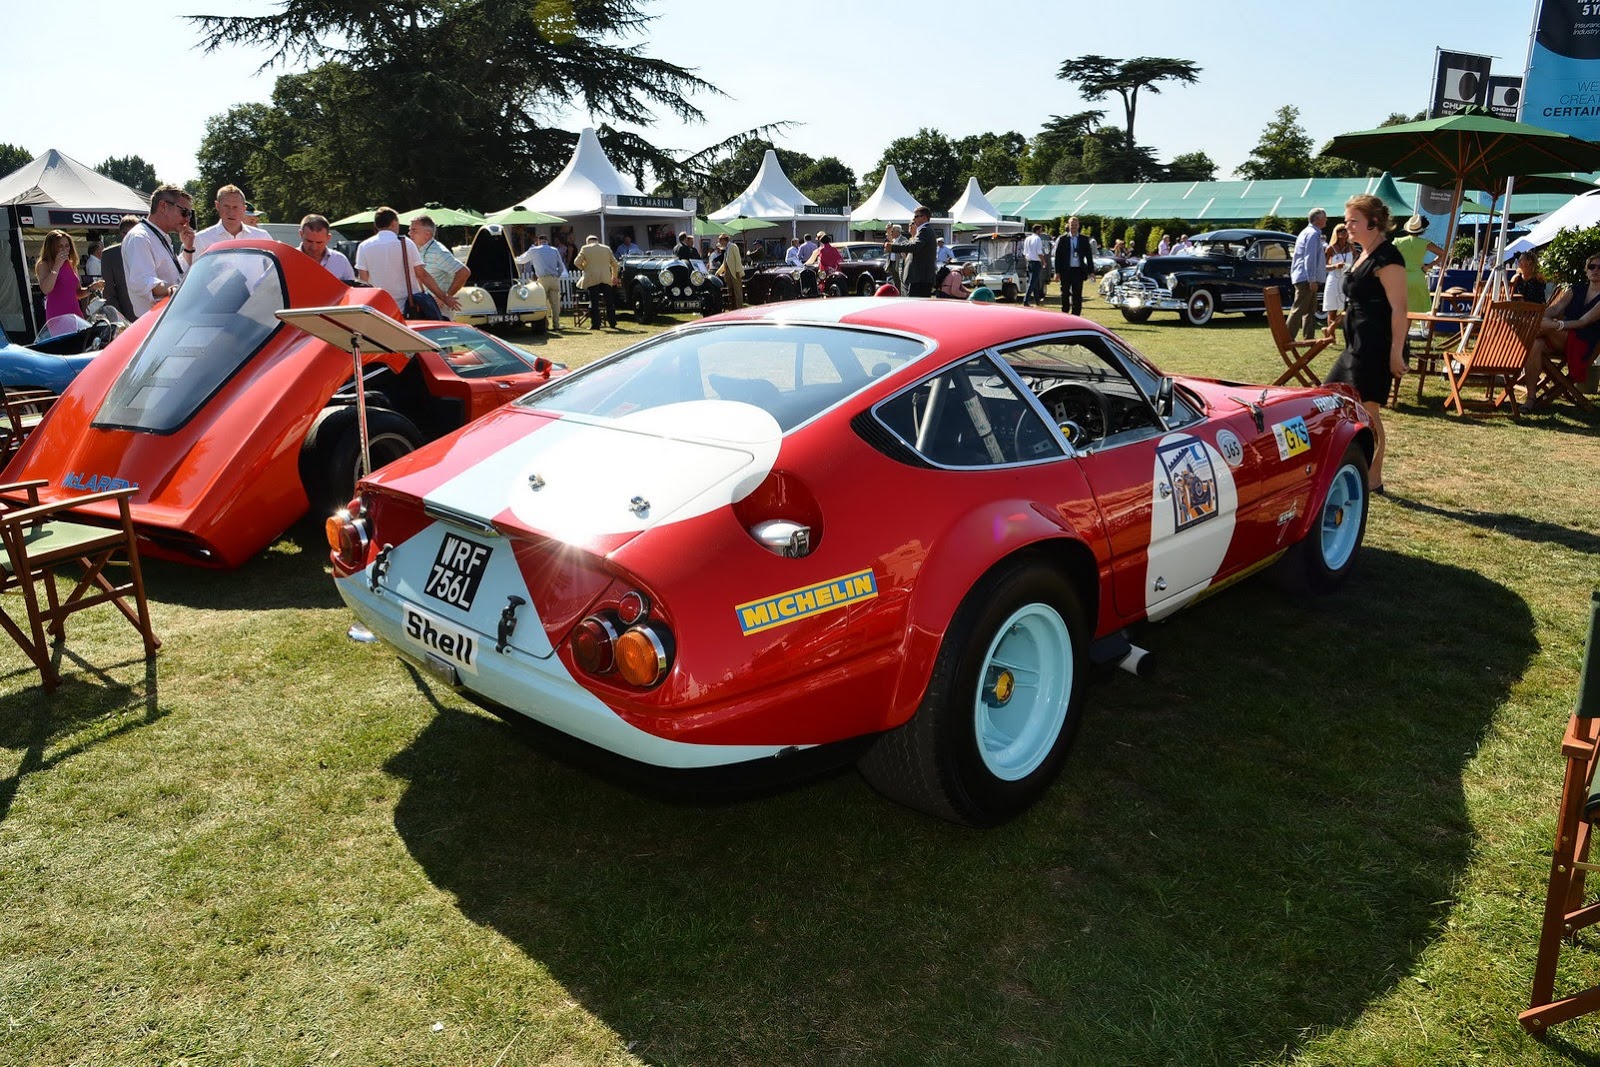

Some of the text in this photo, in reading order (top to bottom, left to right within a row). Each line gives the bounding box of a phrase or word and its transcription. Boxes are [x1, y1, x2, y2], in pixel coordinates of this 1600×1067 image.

[1577, 81, 1599, 92] WE
[629, 197, 674, 208] YAS MARINA
[1223, 441, 1240, 459] 365
[1284, 422, 1308, 450] GTS
[440, 536, 488, 575] WRF
[425, 564, 471, 609] 756L
[741, 574, 873, 629] MICHELIN
[406, 610, 473, 666] Shell
